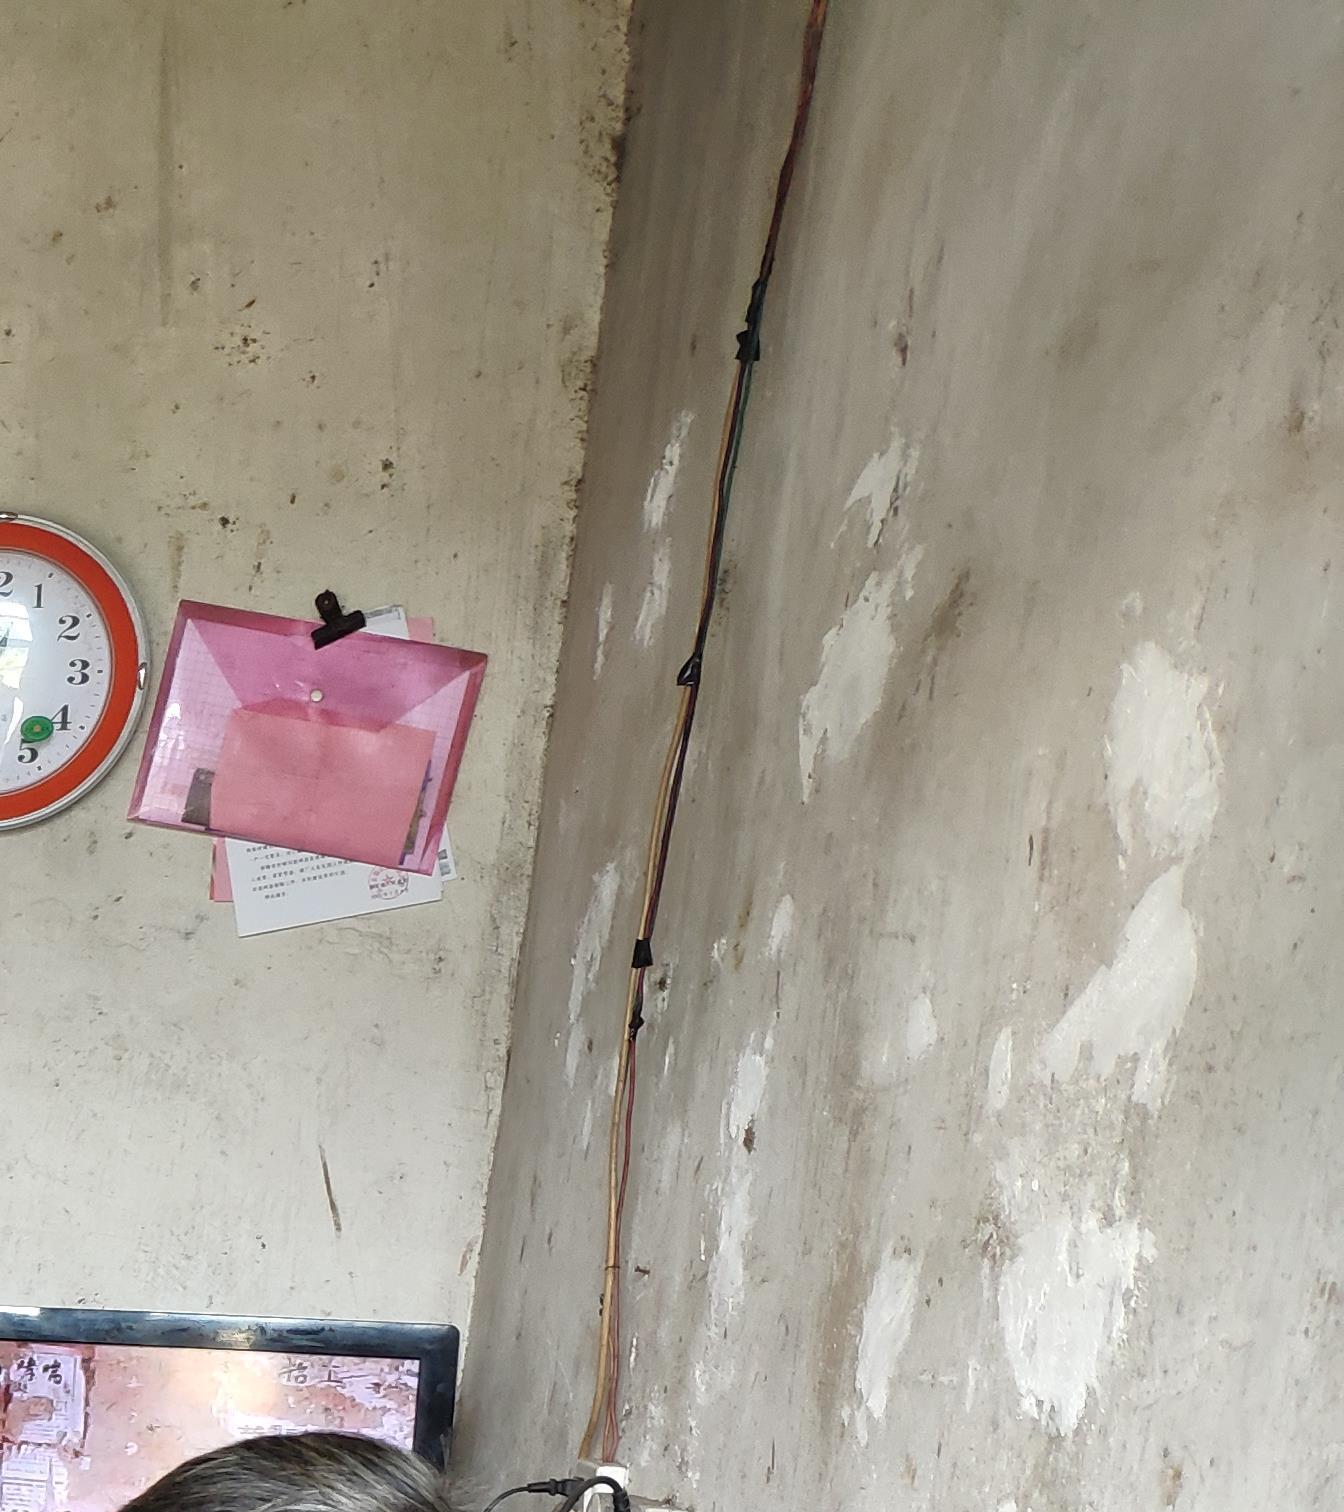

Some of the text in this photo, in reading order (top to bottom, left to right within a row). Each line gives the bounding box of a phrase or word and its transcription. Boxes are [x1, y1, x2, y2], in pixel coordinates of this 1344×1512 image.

[33, 584, 45, 609] 1
[57, 615, 81, 642] 2
[66, 658, 91, 685] 3
[51, 704, 72, 731] 4
[18, 739, 39, 764] 5
